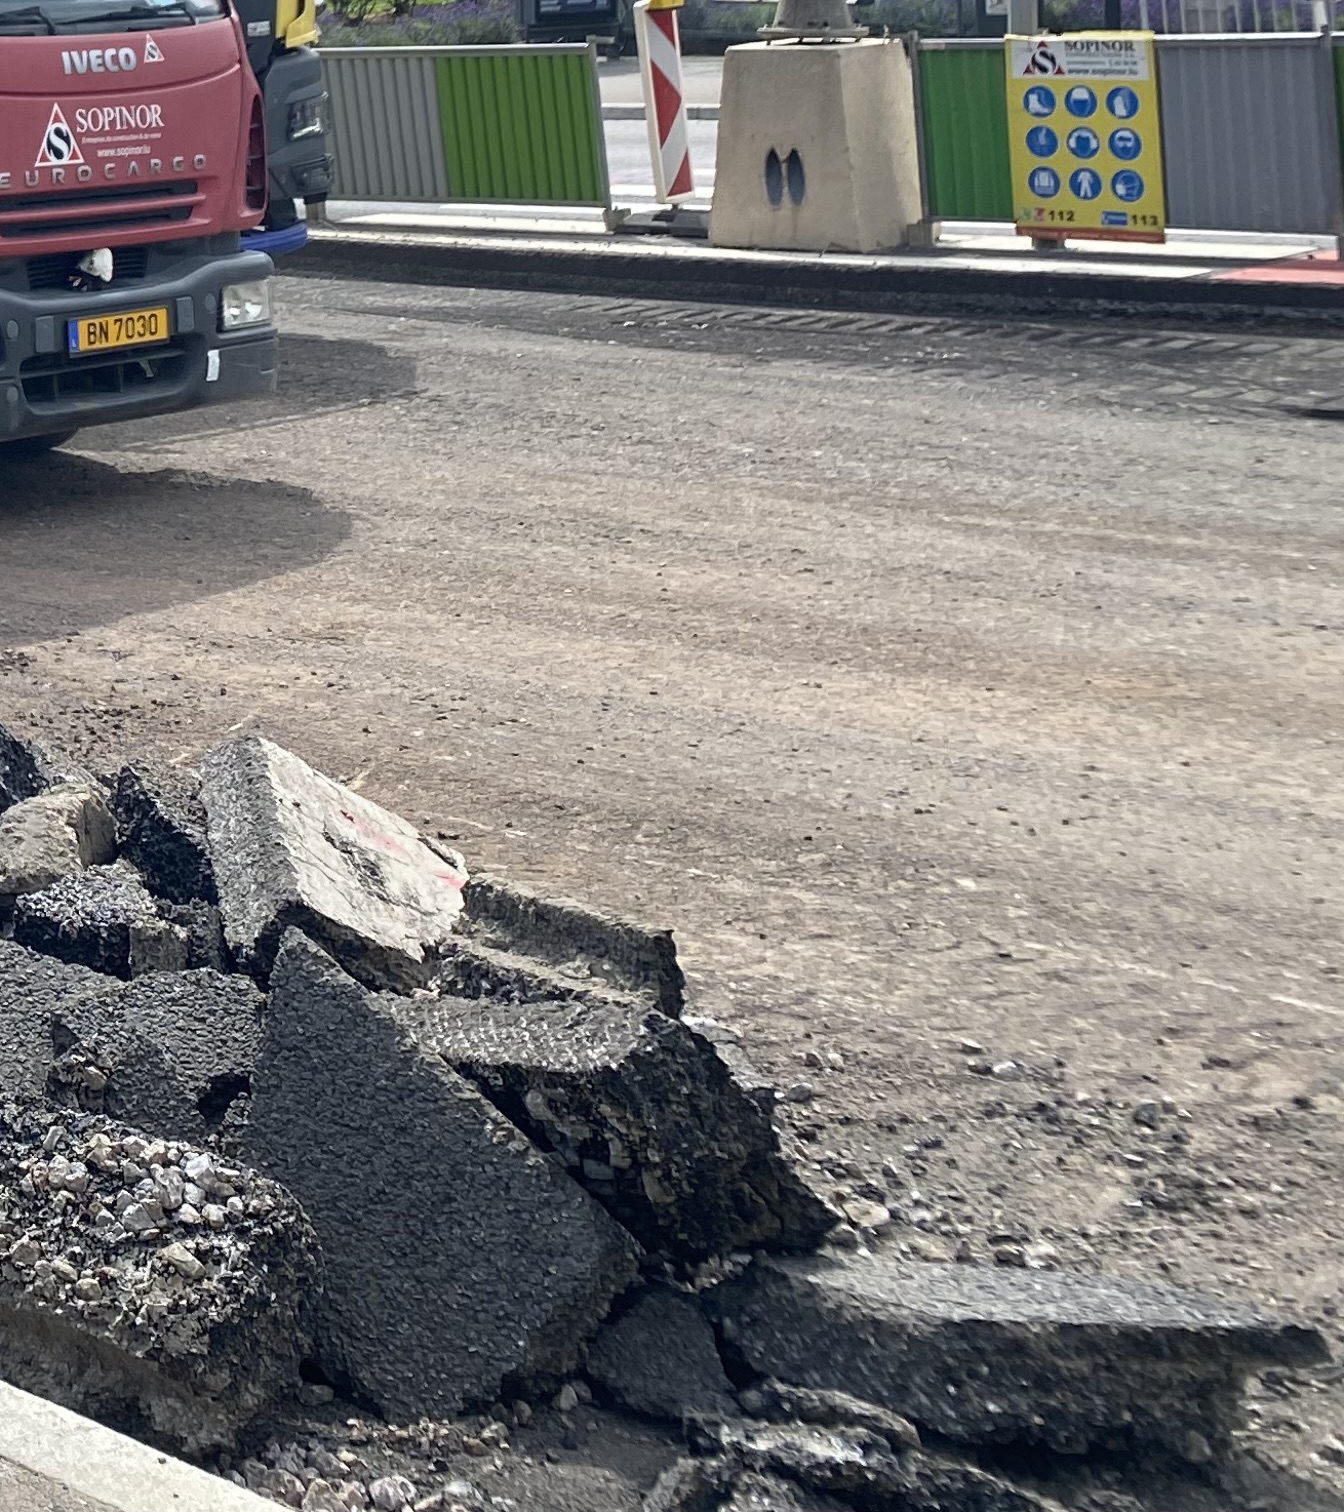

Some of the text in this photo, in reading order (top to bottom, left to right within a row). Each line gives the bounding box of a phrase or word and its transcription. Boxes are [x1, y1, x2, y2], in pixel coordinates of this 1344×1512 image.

[1065, 40, 1135, 53] SOPINOR
[61, 47, 137, 74] IVECO
[75, 104, 165, 133] SOPINOR
[1048, 210, 1075, 222] 112
[1131, 214, 1158, 226] 113
[87, 313, 158, 346] BN 7030
